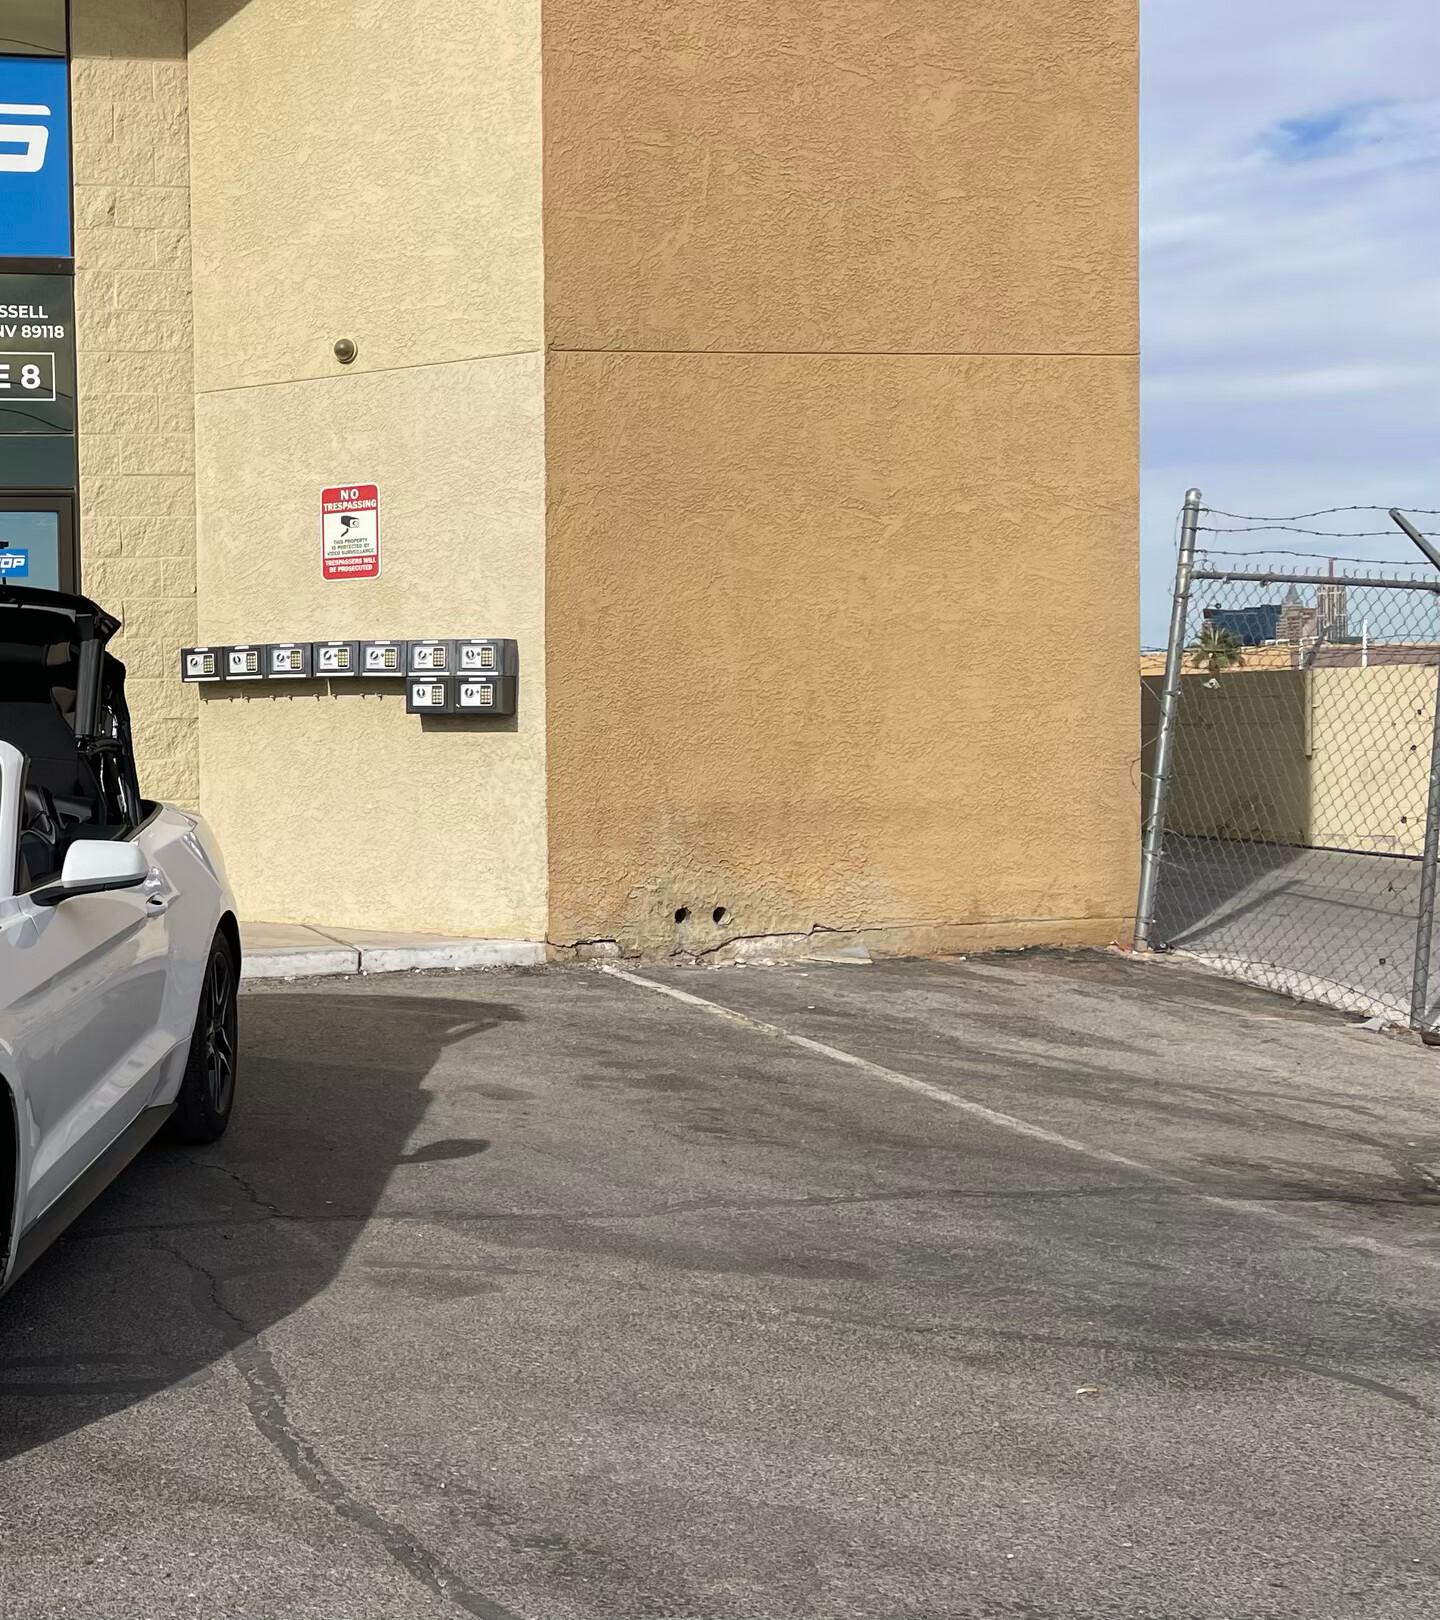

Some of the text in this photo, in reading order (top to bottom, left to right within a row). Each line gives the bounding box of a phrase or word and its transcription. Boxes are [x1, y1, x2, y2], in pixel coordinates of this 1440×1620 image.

[21, 325, 65, 339] 89118
[20, 364, 41, 390] 8
[341, 489, 359, 501] NO
[323, 499, 377, 512] TRESPASSING
